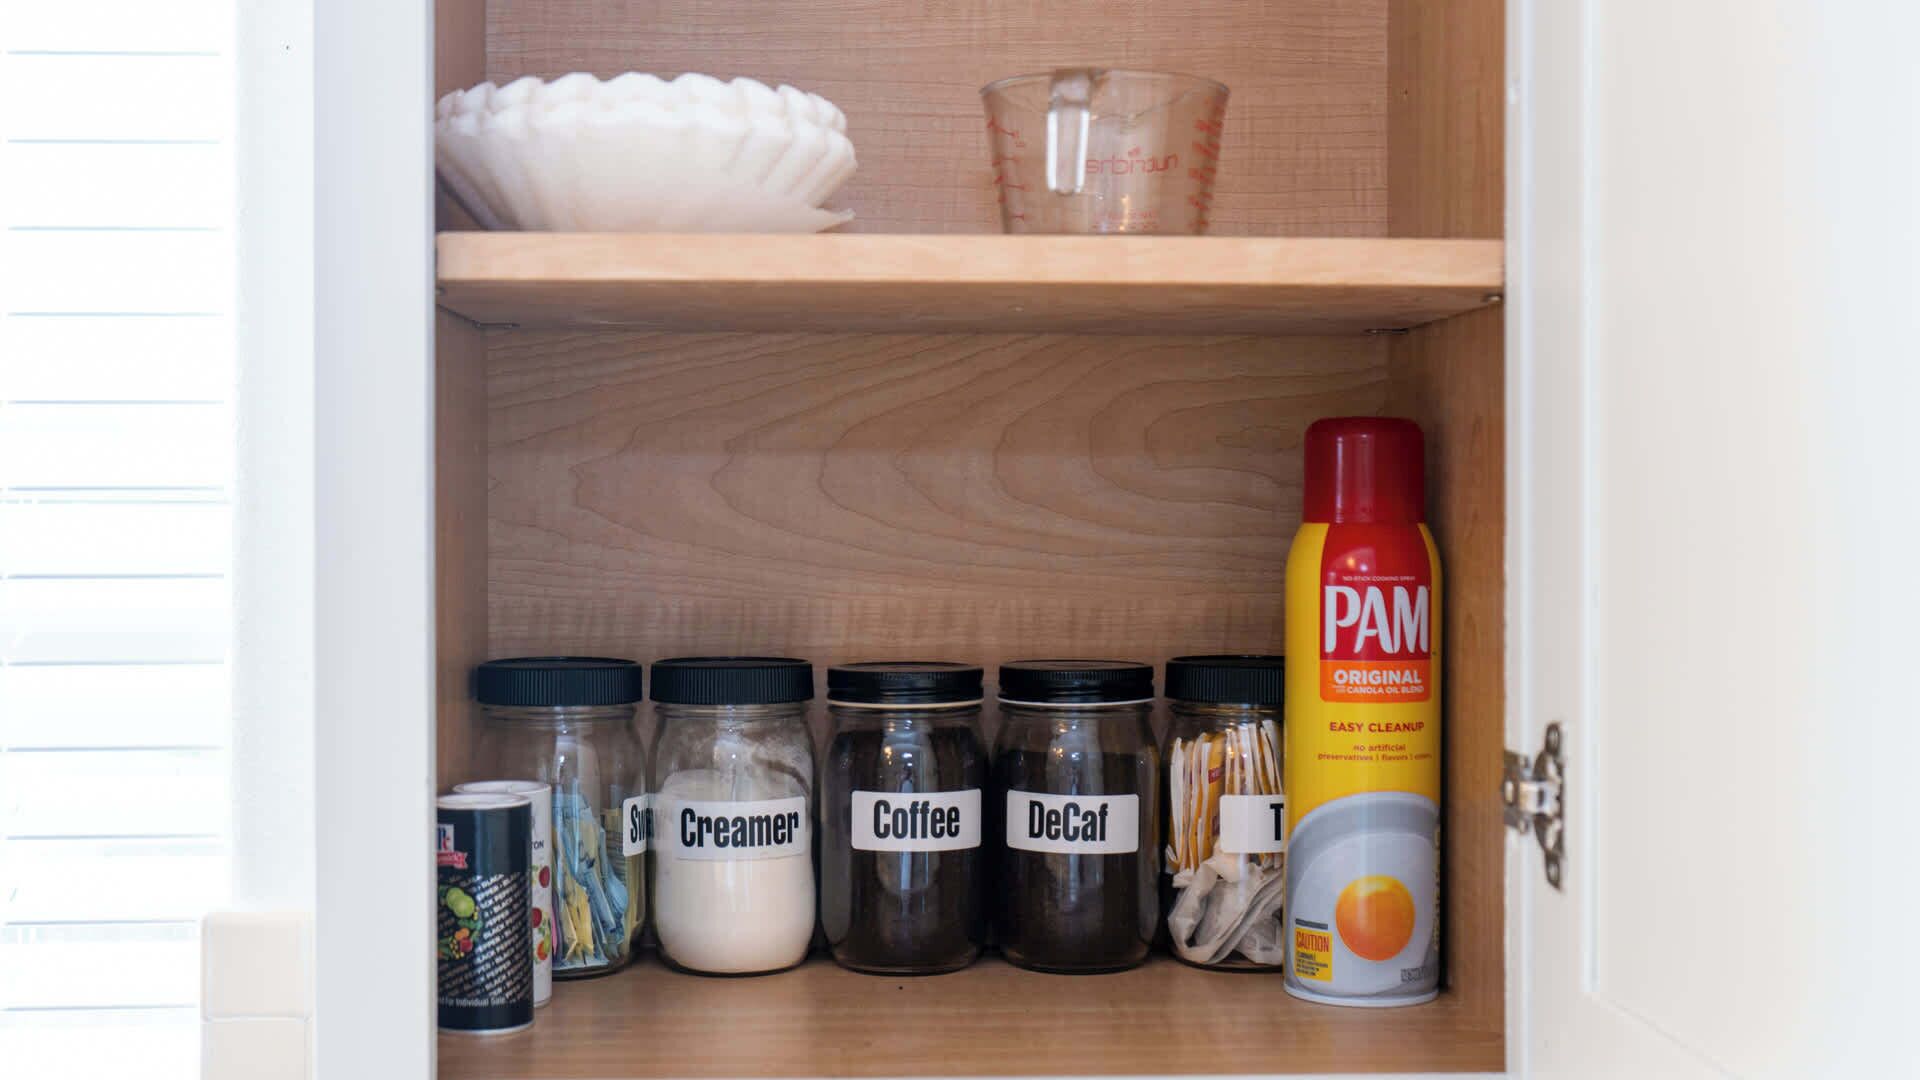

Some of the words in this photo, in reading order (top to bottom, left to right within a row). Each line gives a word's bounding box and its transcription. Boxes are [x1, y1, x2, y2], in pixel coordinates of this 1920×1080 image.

[1324, 585, 1430, 655] PAM
[1333, 669, 1422, 685] ORIGINAL
[1347, 686, 1385, 695] CANOLA
[1385, 686, 1400, 694] OIL
[1329, 722, 1364, 732] EASY
[1368, 721, 1425, 733] CLEANUP
[1368, 743, 1406, 752] artificial
[680, 807, 800, 848] Creamer
[873, 799, 960, 839] Coffee
[1028, 800, 1109, 842] DeCaf
[1269, 803, 1284, 841] T
[1296, 931, 1330, 952] CAUTION
